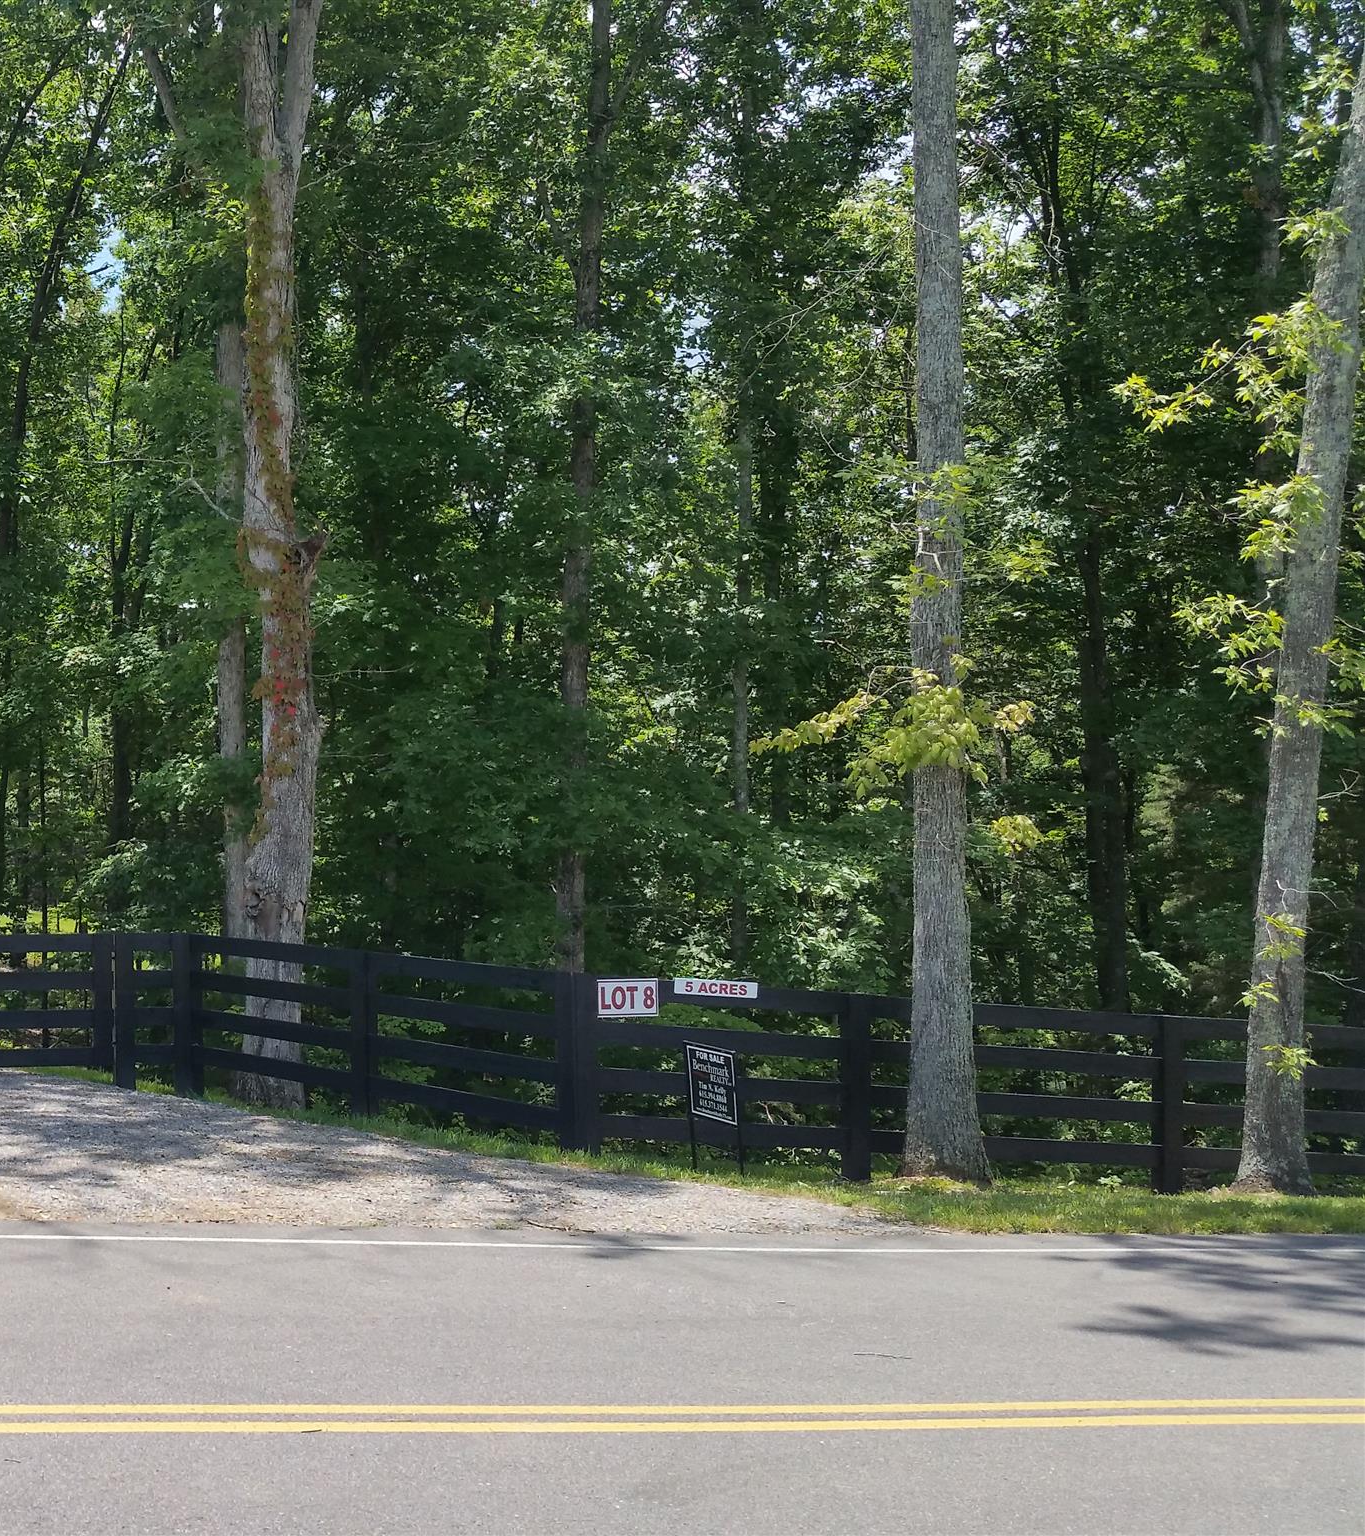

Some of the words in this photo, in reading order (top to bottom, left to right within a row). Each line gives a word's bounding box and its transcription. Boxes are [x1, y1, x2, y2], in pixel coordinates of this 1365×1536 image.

[685, 981, 693, 992] 5
[698, 982, 748, 996] ACRES
[600, 986, 638, 1010] LOT
[643, 986, 655, 1009] 8
[695, 1051, 708, 1060] FOR
[708, 1054, 725, 1065] SALE
[692, 1059, 730, 1077] Benchmark
